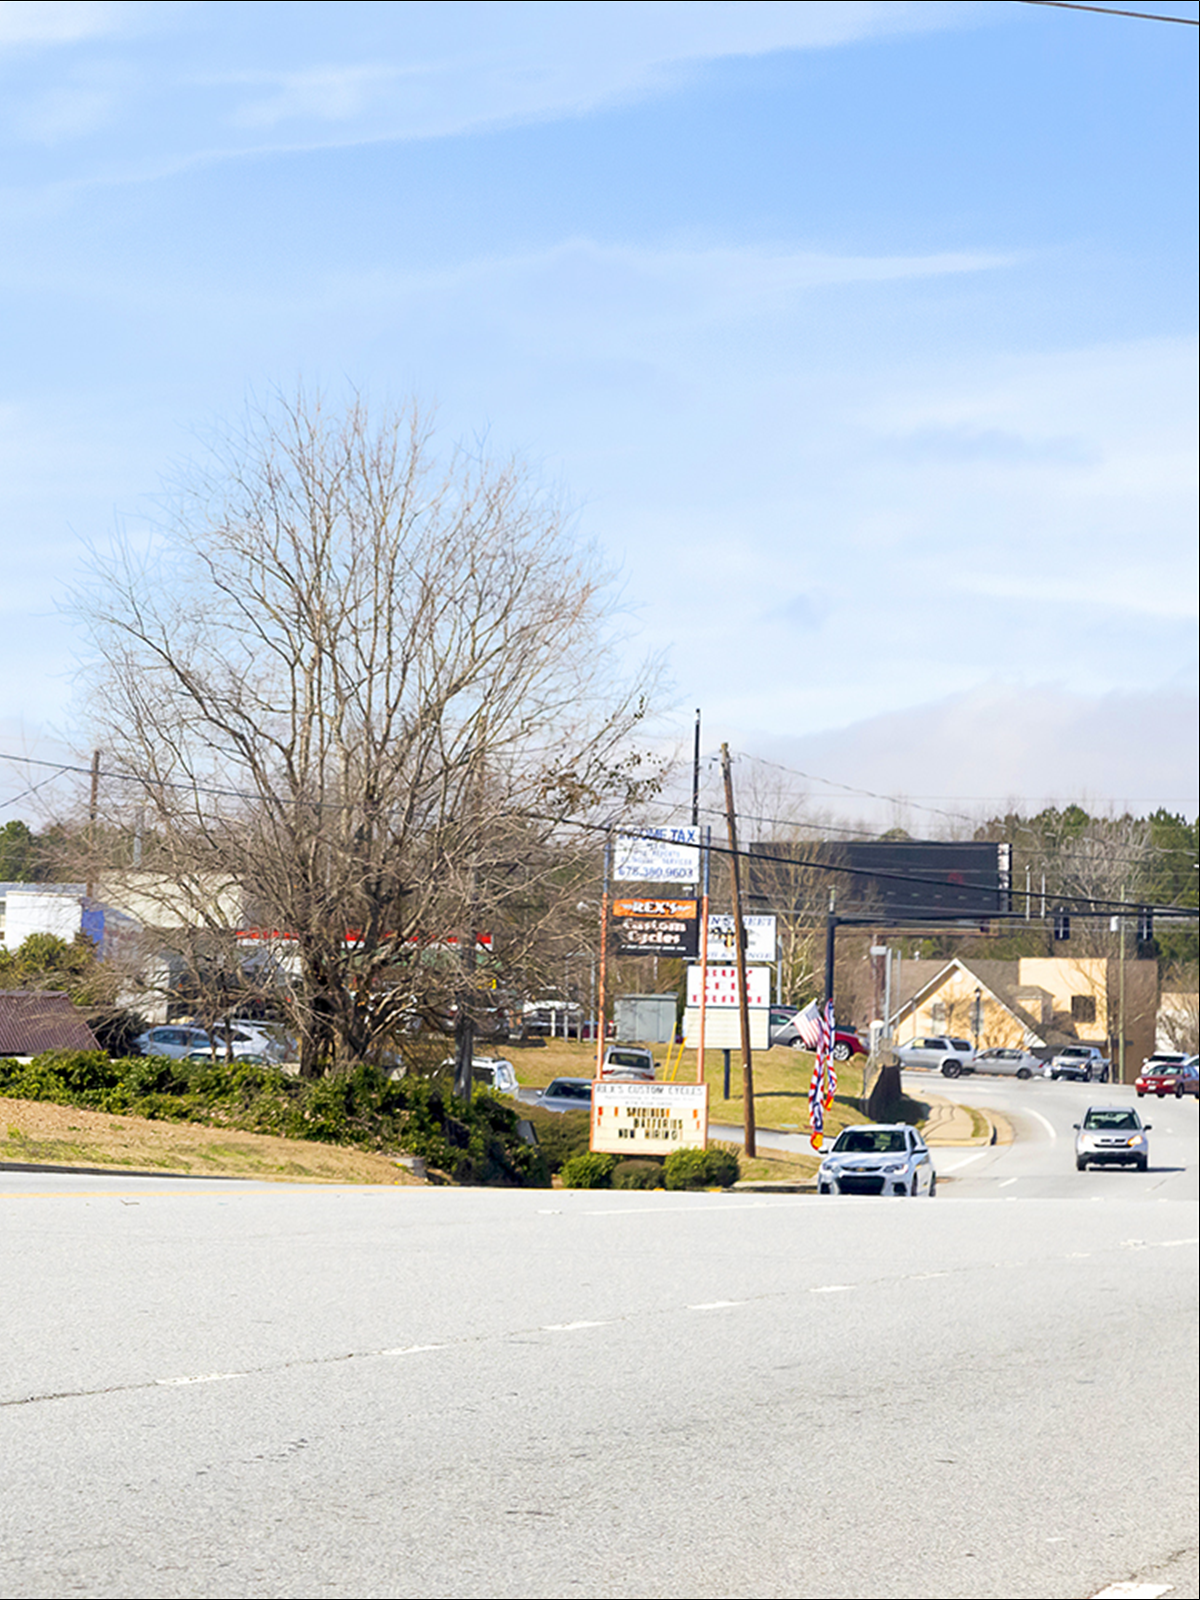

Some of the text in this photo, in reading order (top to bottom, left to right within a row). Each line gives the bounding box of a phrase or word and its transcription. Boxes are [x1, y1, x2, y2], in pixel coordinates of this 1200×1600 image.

[670, 828, 696, 842] TAX
[632, 901, 679, 914] REX'S
[622, 918, 687, 932] Custom
[627, 931, 681, 944] Cycles
